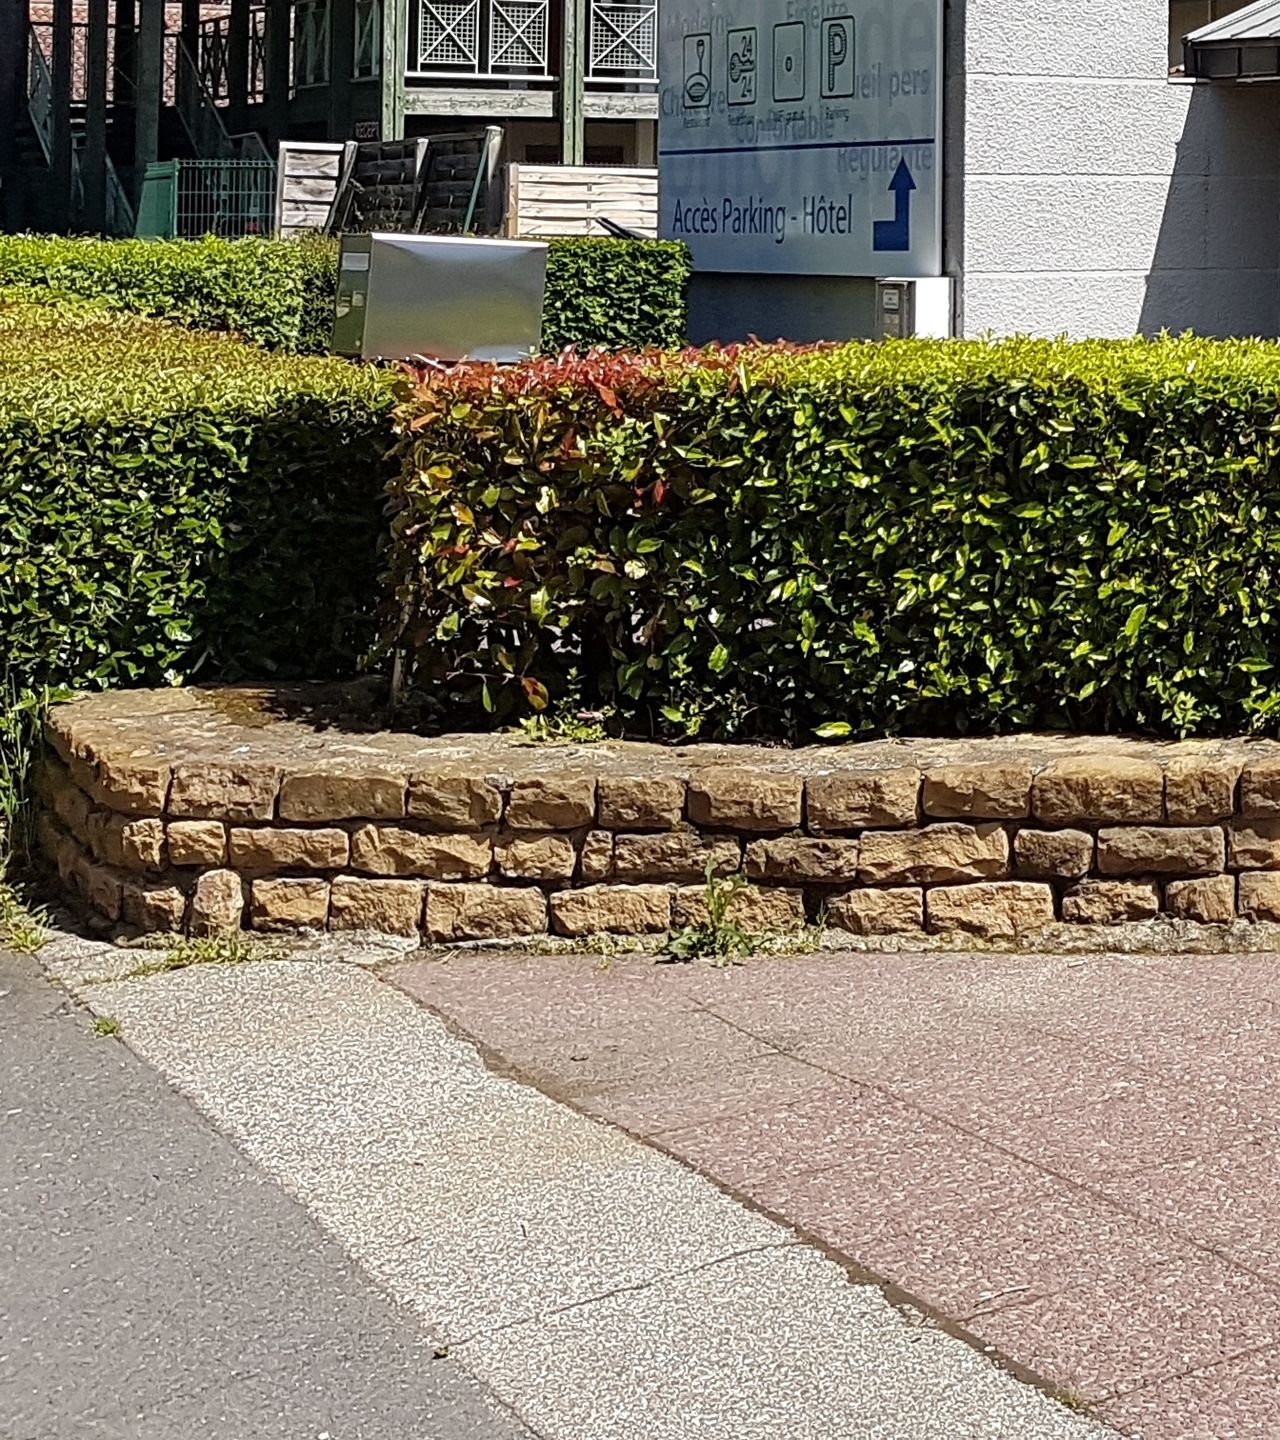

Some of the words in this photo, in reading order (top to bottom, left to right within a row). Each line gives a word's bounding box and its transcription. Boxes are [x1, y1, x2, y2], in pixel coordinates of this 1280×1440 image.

[672, 197, 717, 234] Accès
[723, 195, 787, 244] Parking
[803, 193, 852, 234] Hôtel
